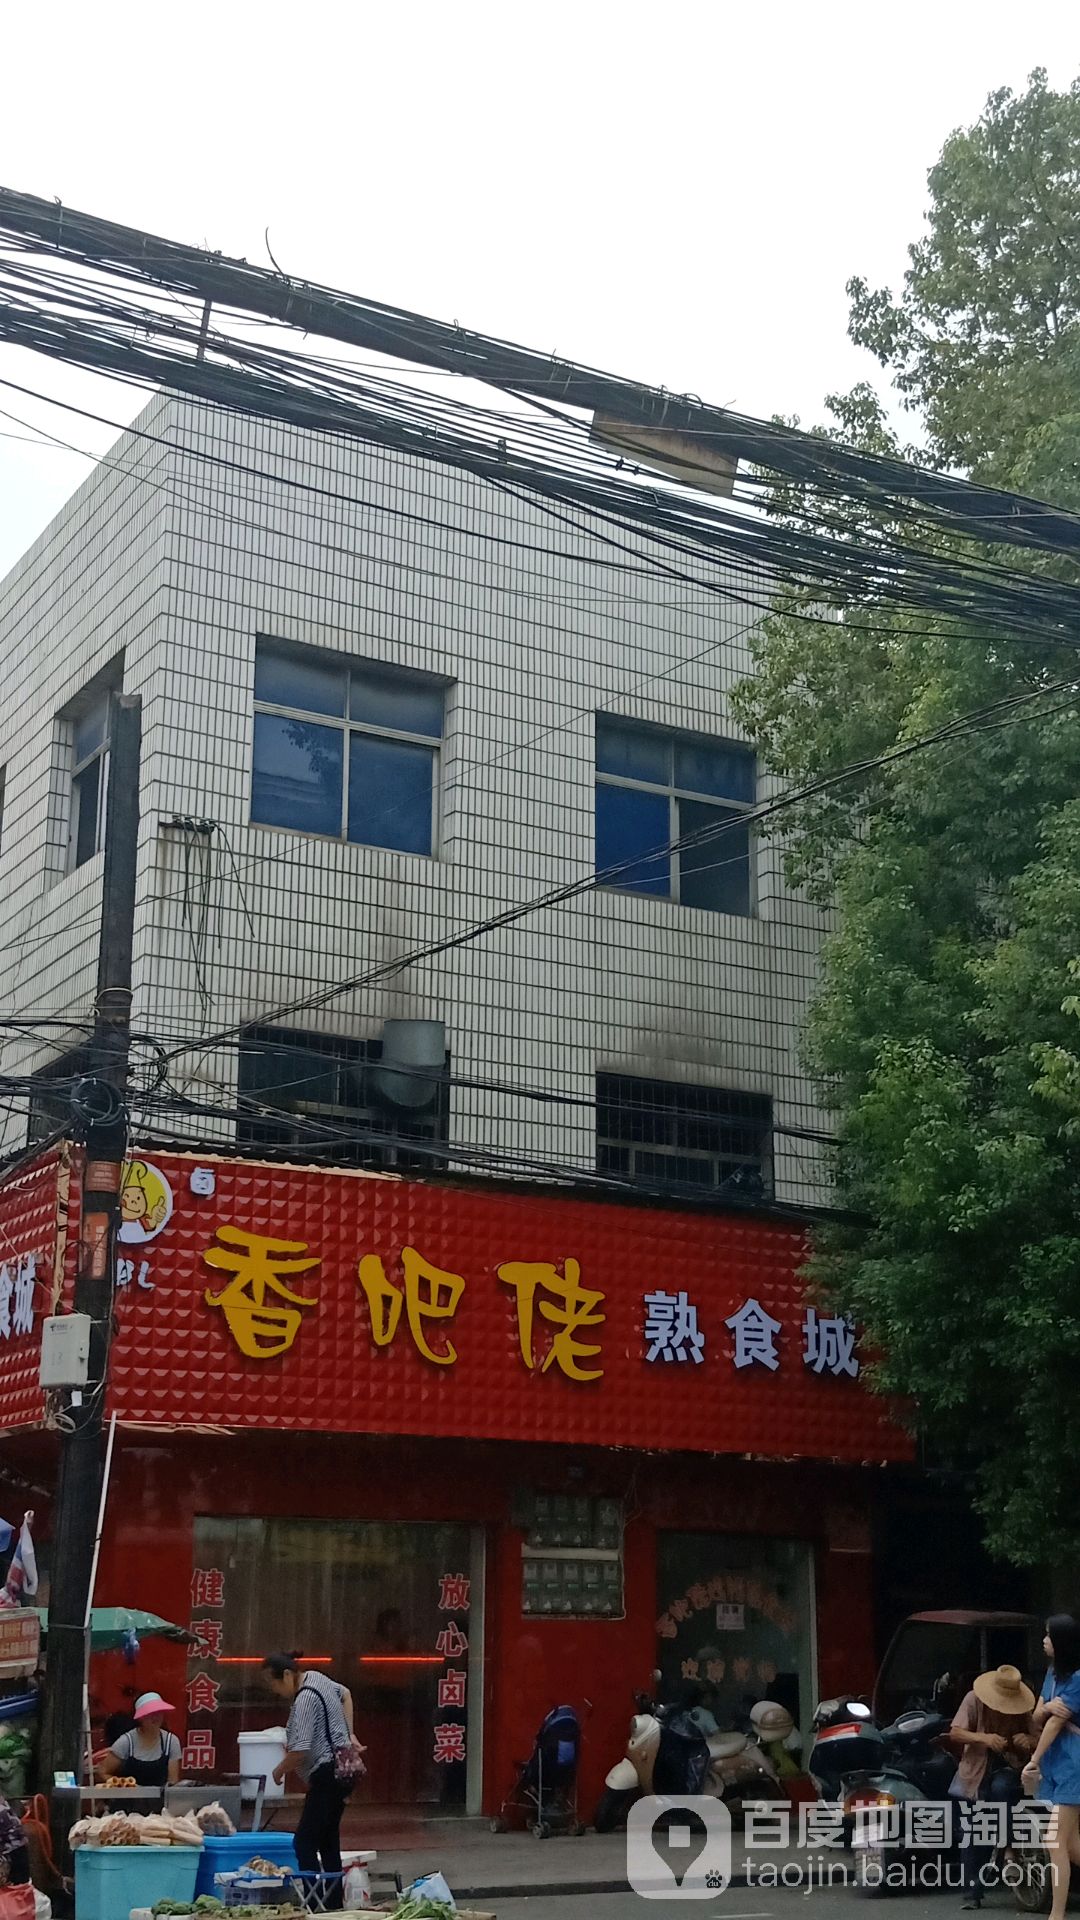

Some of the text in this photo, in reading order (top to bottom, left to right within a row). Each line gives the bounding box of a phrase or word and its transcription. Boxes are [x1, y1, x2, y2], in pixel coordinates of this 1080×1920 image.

[204, 1225, 606, 1382] 香吧佬
[644, 1289, 860, 1378] 熟食城
[181, 1567, 226, 1770] 健康食品
[433, 1573, 471, 1763] 放心卤菜
